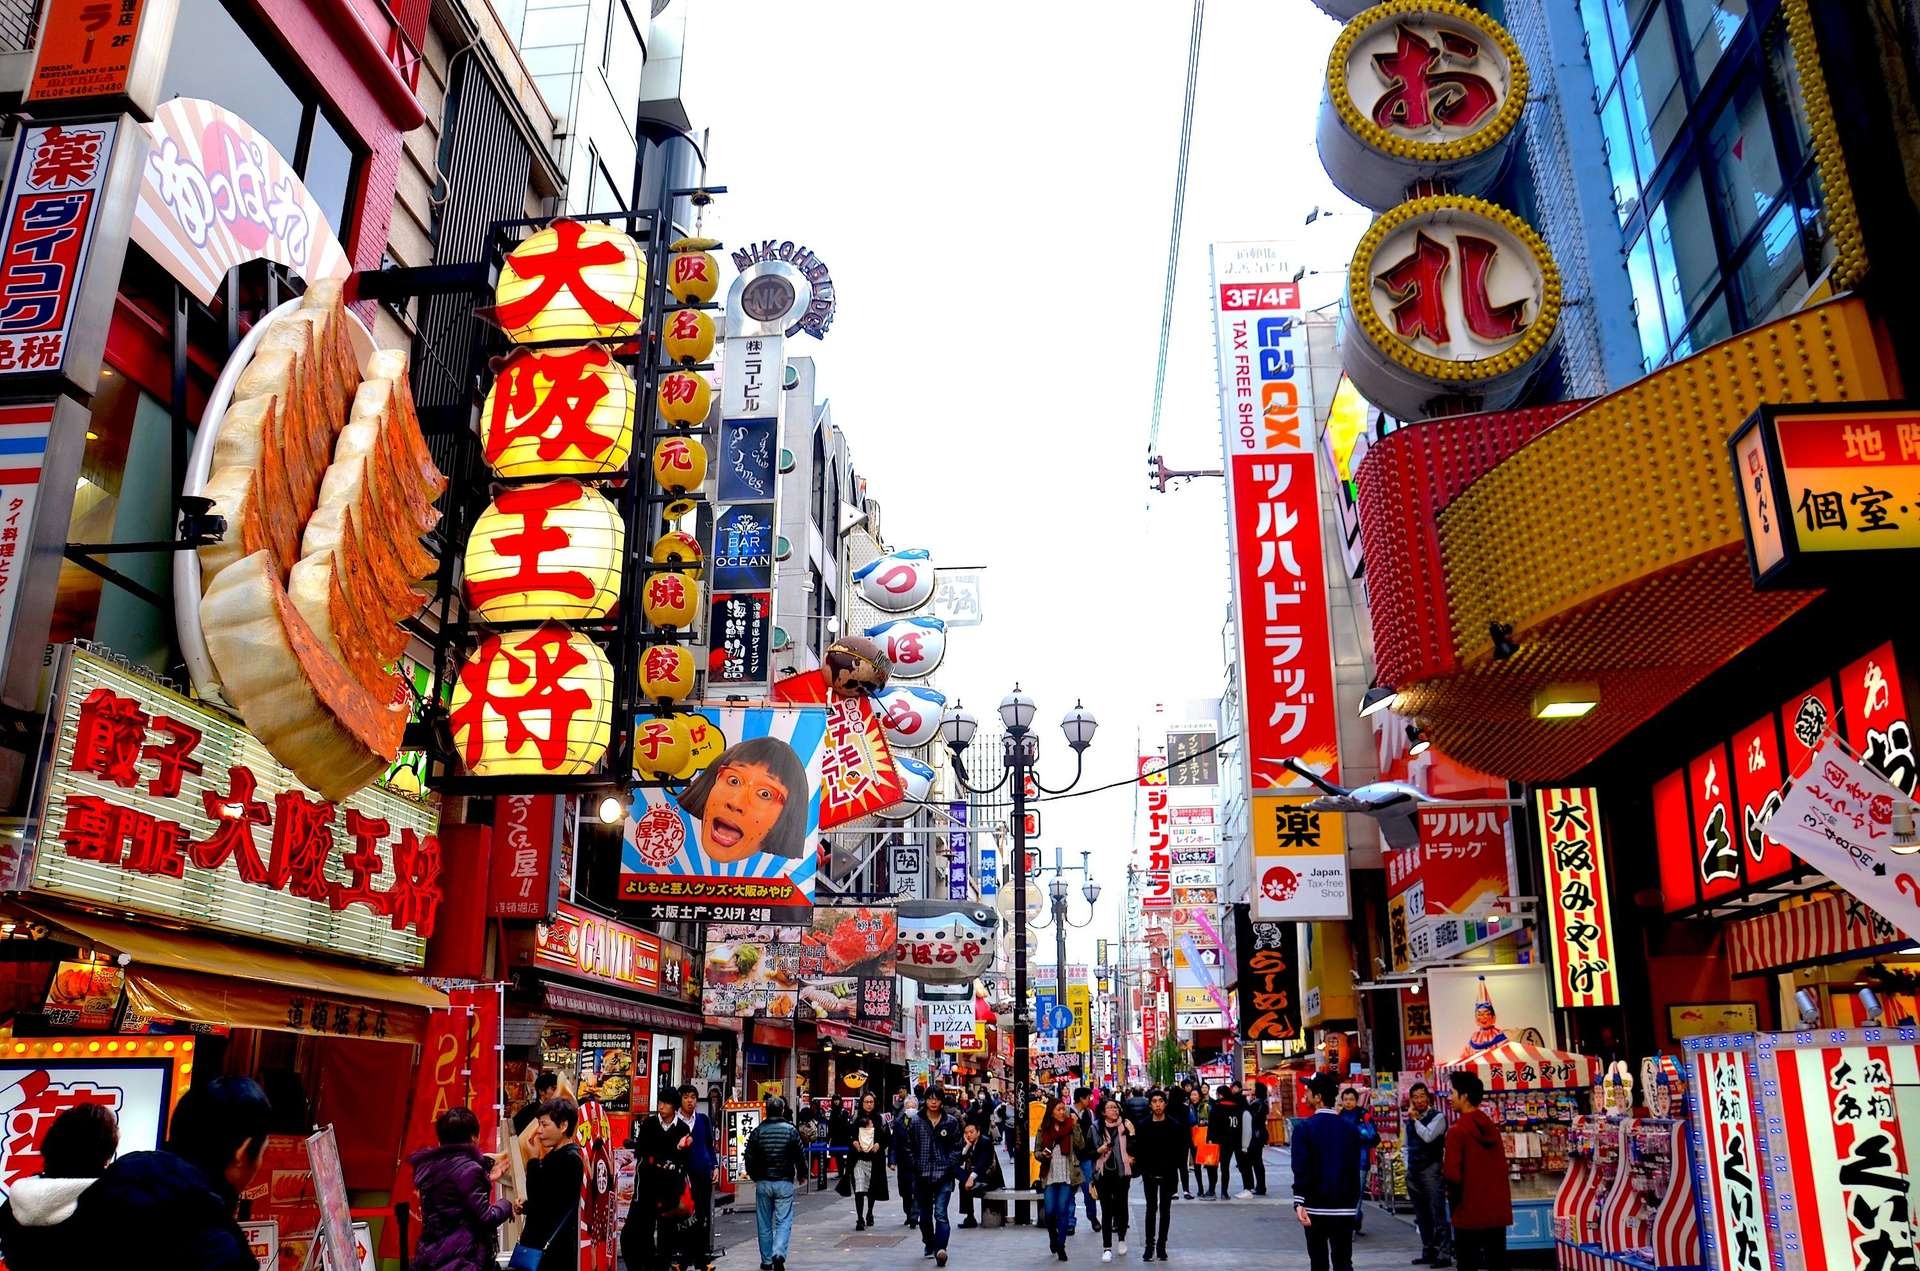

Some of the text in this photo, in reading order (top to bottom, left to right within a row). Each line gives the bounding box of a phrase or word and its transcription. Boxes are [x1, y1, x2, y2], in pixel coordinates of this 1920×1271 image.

[112, 34, 131, 47] 2F
[40, 69, 98, 79] RESTAURANT
[108, 64, 126, 72] BAR
[41, 64, 73, 72] INDIAN
[29, 126, 103, 190] 薬
[1, 193, 86, 331] ダイコク
[751, 286, 785, 311] NK
[1226, 287, 1294, 306] 3F/4F
[1233, 320, 1254, 449] TAX FREE SHOP
[731, 449, 765, 488] James
[448, 217, 648, 770] 大阪王将
[639, 254, 708, 760] 阪名物元焼餃子
[1797, 486, 1920, 532] 個室・
[729, 537, 761, 548] BAR
[715, 556, 770, 567] OCEAN
[1252, 464, 1314, 744] ツルハドラッグ
[72, 687, 203, 798] 餃子
[1276, 805, 1320, 847] 薬
[1423, 812, 1502, 837] ツルハ
[189, 766, 444, 938] 大阪王将
[1148, 789, 1170, 896] ジャンカラ
[1425, 841, 1488, 860] ドラッグ
[898, 853, 917, 868] 牛角
[981, 857, 997, 888] 焼肉
[1307, 880, 1344, 888] Tax-free
[1310, 868, 1343, 879] Japan.
[1321, 889, 1345, 899] Shop
[1549, 800, 1609, 994] 大阪みやげ
[495, 902, 540, 914] 道頓堀店
[580, 919, 636, 983] GAME
[897, 942, 980, 965] づぼらや
[1248, 950, 1295, 1040] らーめん
[287, 999, 390, 1037] 道頓堀本店
[932, 1004, 972, 1015] PASTA
[1184, 1015, 1215, 1025] ZAZA
[1408, 1005, 1431, 1036] 薬
[934, 1021, 972, 1032] PIZZA
[962, 1037, 975, 1047] 2F
[1491, 1064, 1575, 1082] 大阪みやげ
[1715, 1063, 1737, 1088] 大阪
[1835, 1062, 1887, 1087] 大阪
[1719, 1097, 1742, 1121] 名物
[1838, 1096, 1892, 1121] 名物
[1228, 1115, 1239, 1128] 10
